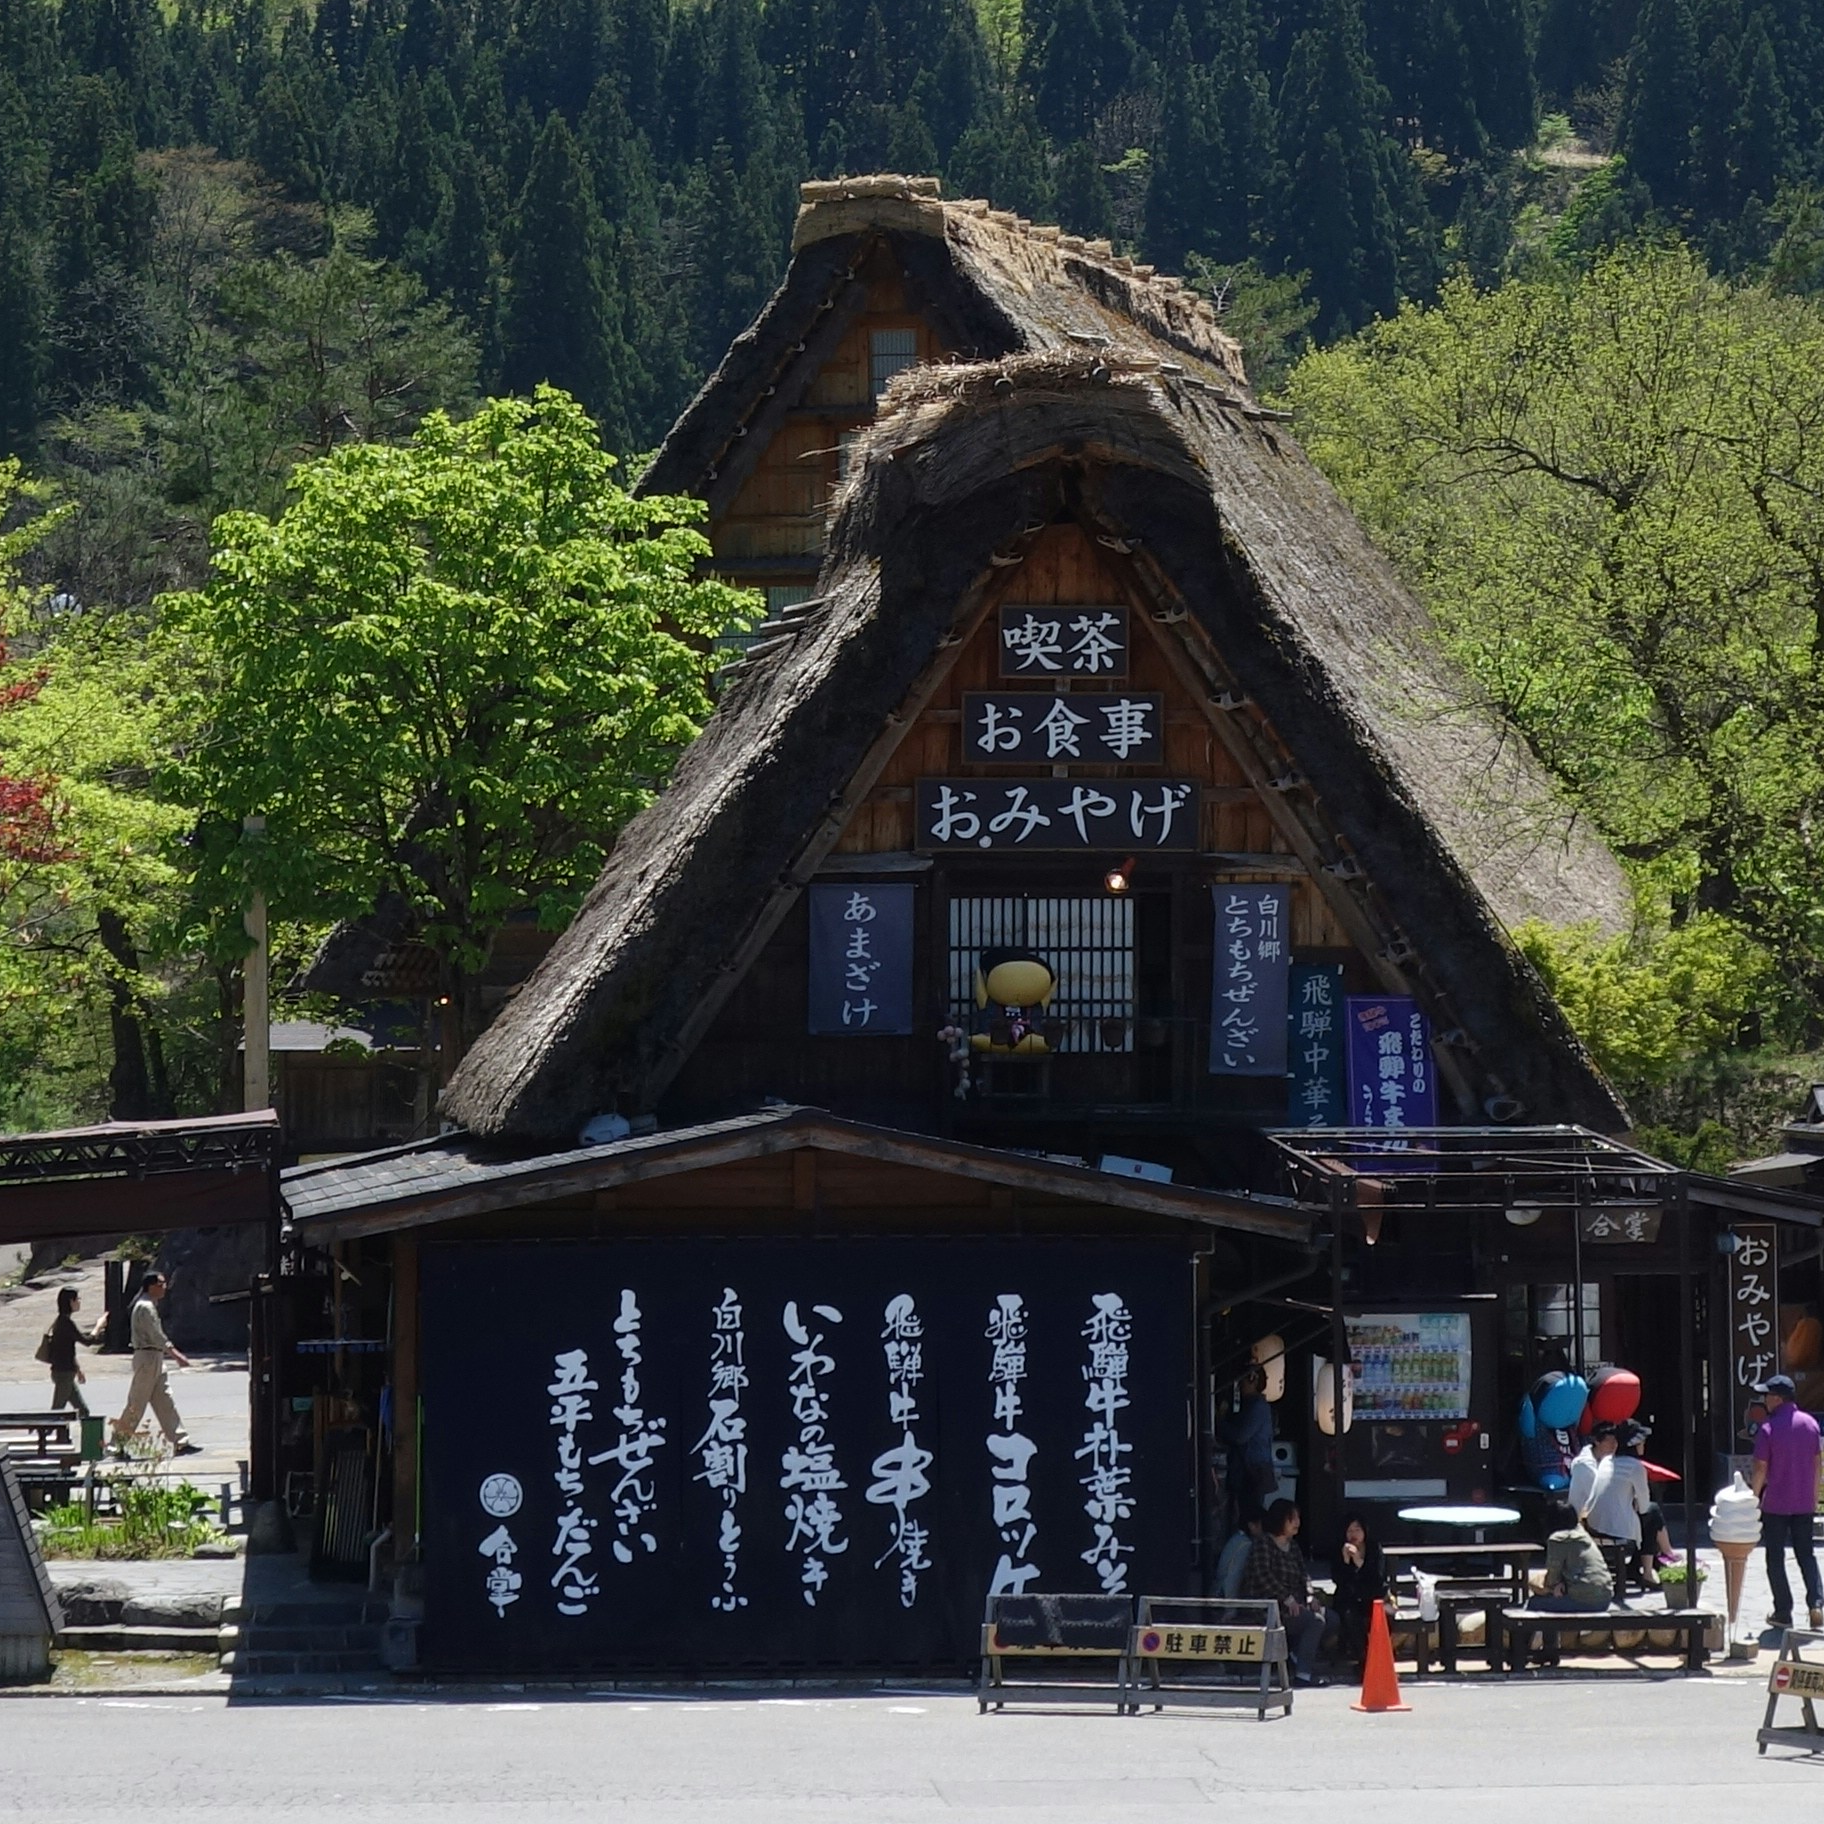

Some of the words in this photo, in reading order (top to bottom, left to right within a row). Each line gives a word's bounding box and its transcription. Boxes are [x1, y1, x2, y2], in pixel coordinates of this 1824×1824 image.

[1002, 612, 1125, 674] 喫茶
[977, 698, 1154, 759] お食事
[930, 784, 1191, 846] おみやげ
[841, 891, 882, 1028] あまざけ
[1221, 895, 1259, 1067] とちもちぜんざい
[1257, 893, 1281, 964] 白川郷
[1736, 1233, 1776, 1389] おみやげ
[780, 1300, 850, 1607] いわなの塩焼き
[865, 1293, 934, 1608] 飛騨牛串焼き
[984, 1293, 1041, 1595] 飛騨牛コロッケ
[1164, 1631, 1257, 1657] 駐車禁止
